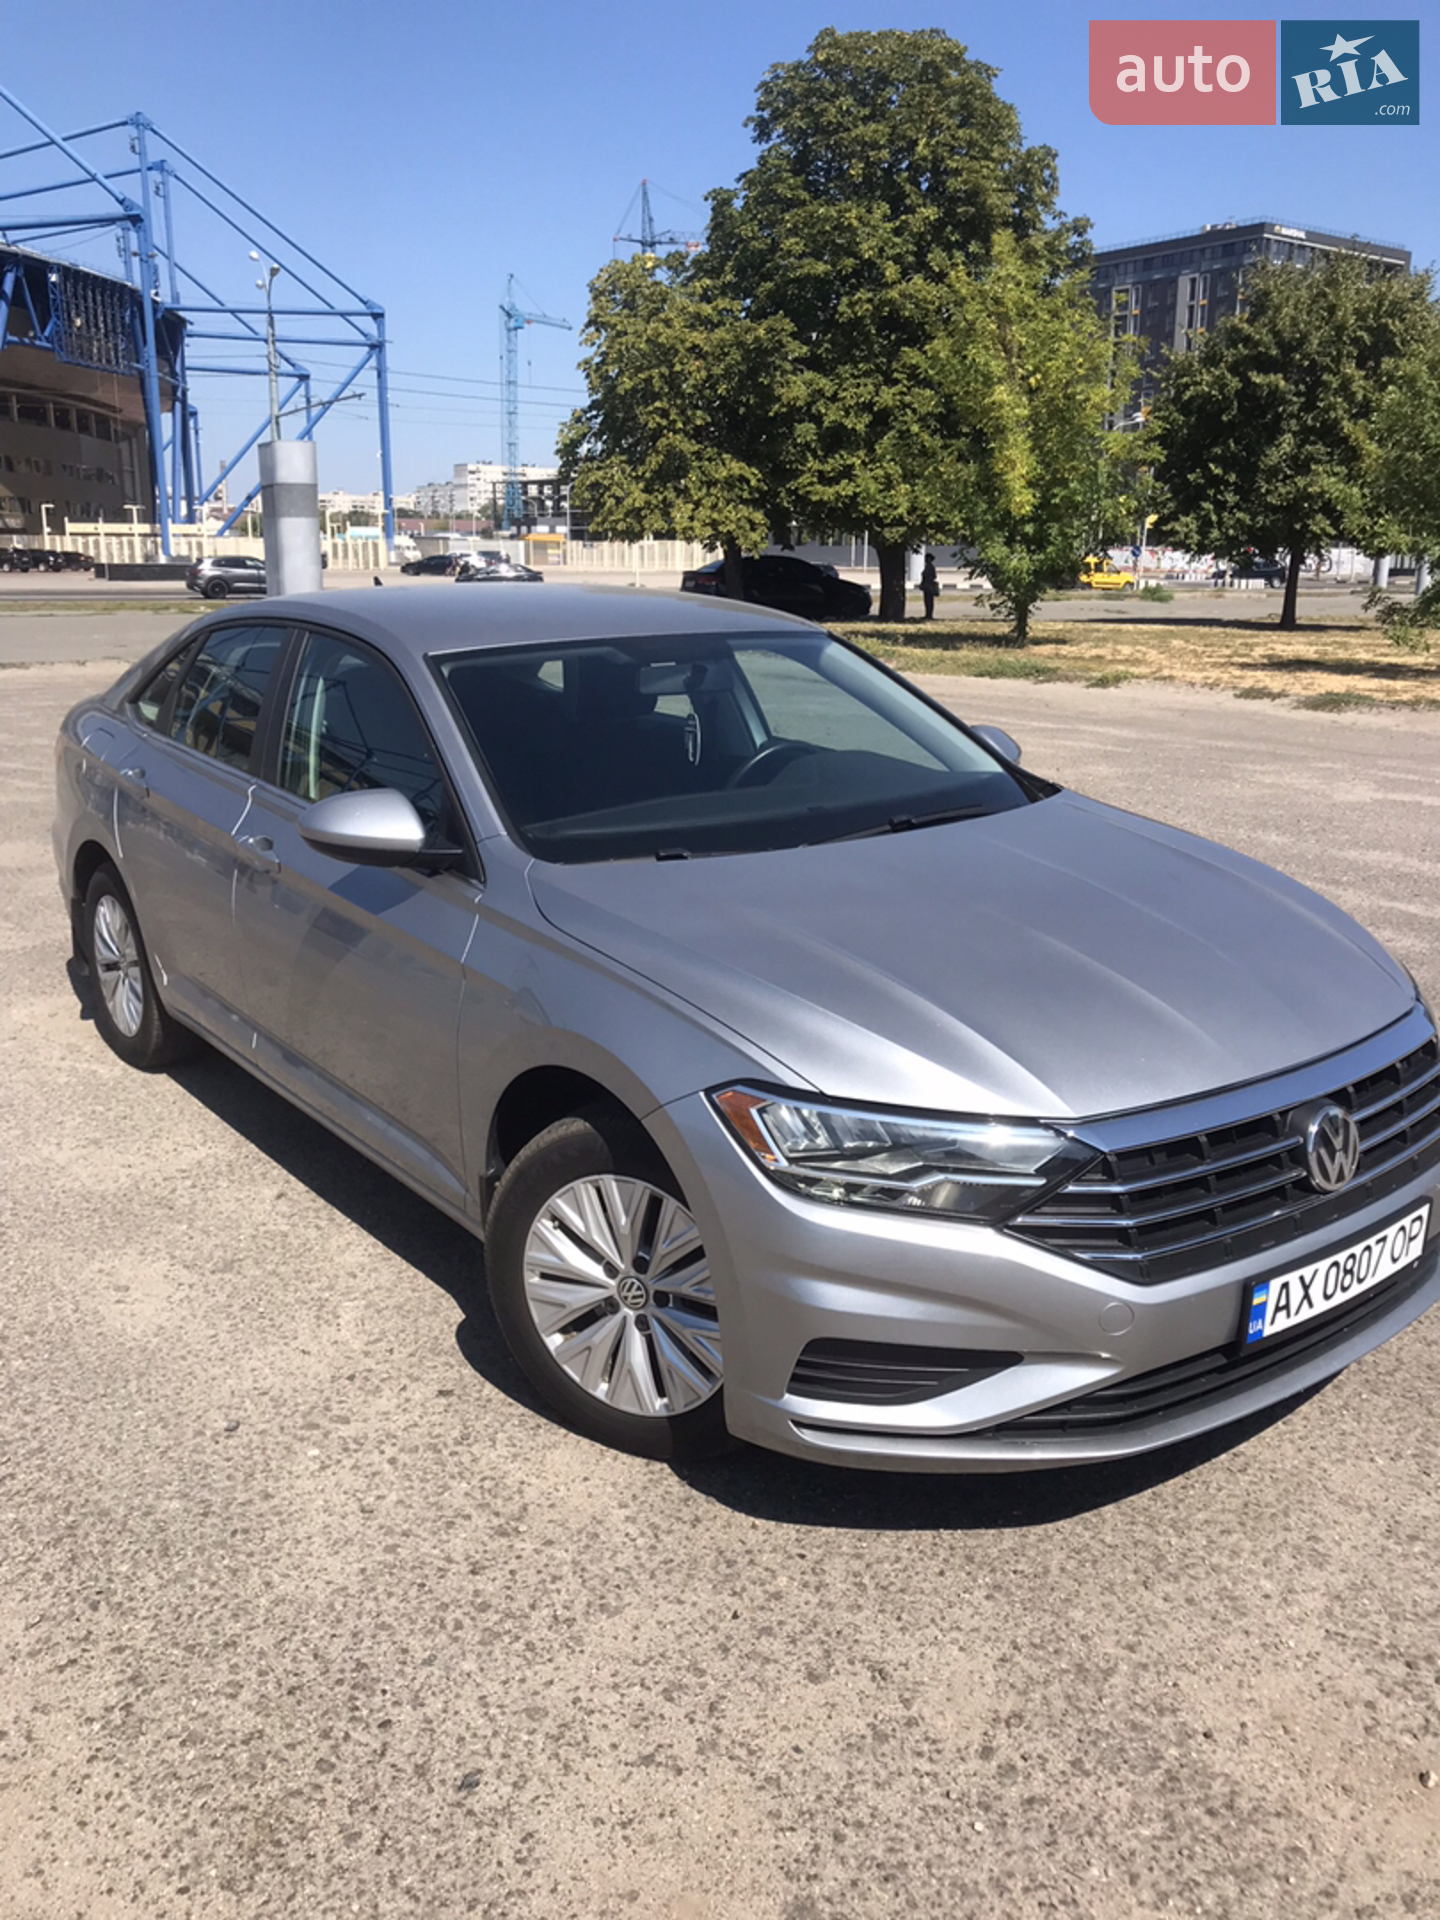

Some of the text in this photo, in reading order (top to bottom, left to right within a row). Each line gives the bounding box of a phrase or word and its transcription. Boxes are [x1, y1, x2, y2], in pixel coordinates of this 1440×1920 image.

[1269, 1214, 1424, 1326] AX 0807 OP
[1249, 1319, 1263, 1334] UA
